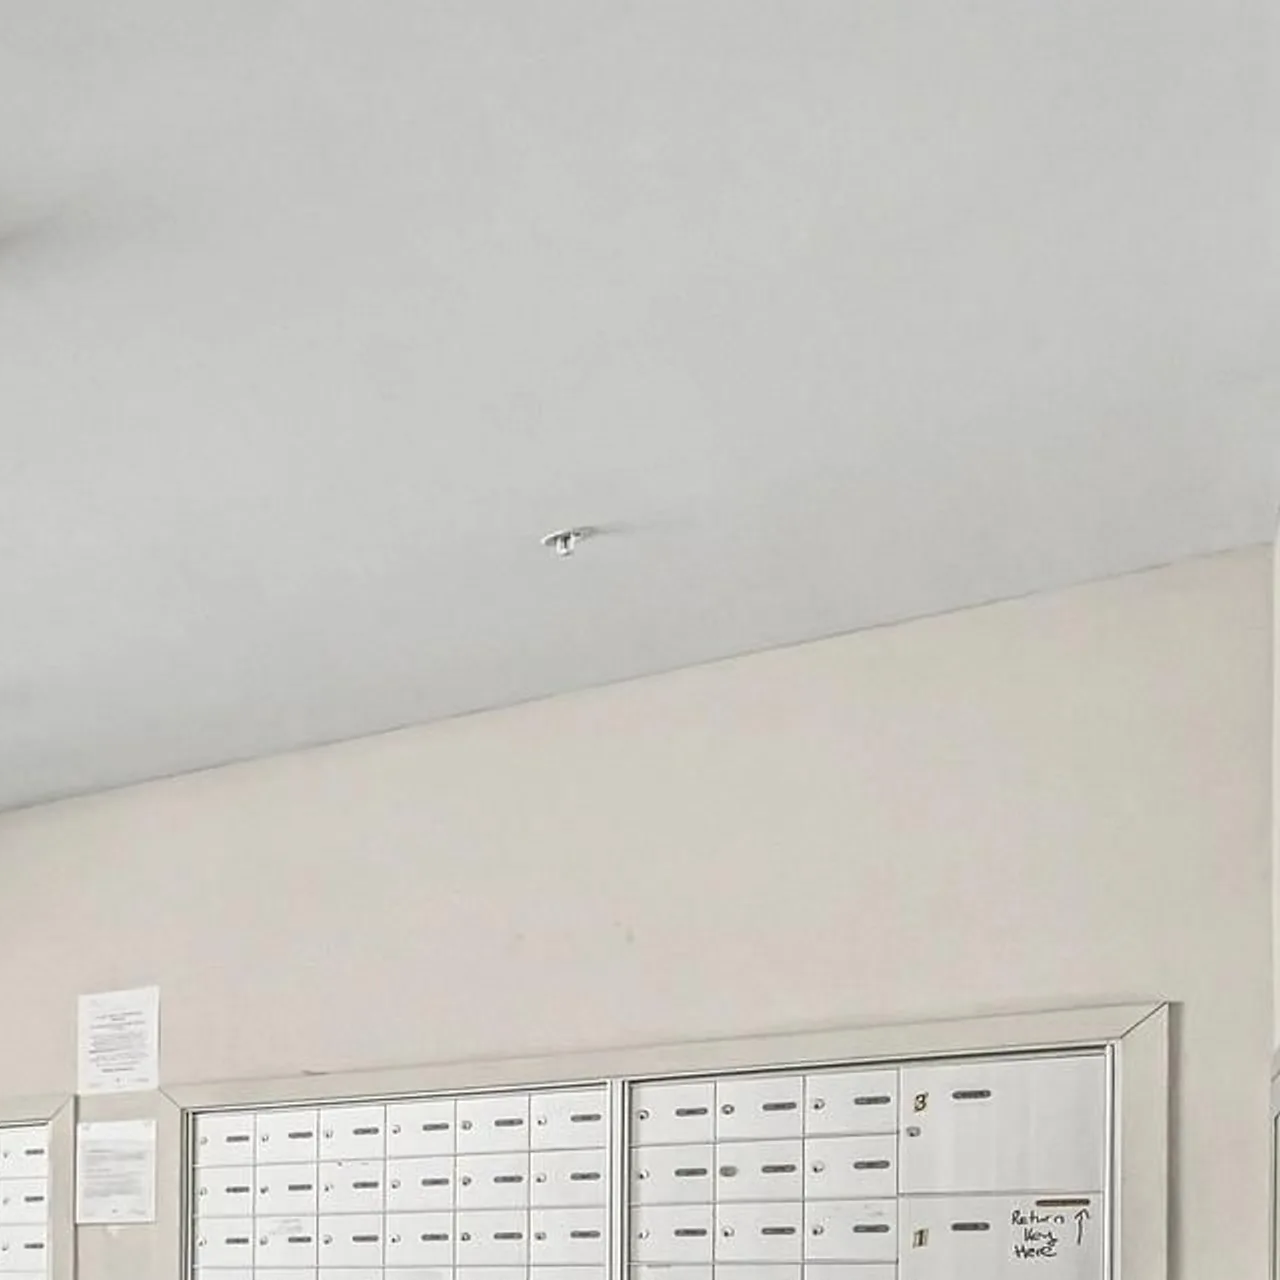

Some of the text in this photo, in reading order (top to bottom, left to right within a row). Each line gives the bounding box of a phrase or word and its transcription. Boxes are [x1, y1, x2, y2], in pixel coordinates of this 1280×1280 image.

[914, 1094, 928, 1112] 3
[1011, 1209, 1066, 1225] Return
[1023, 1227, 1058, 1247] Key
[1013, 1244, 1058, 1259] Here
